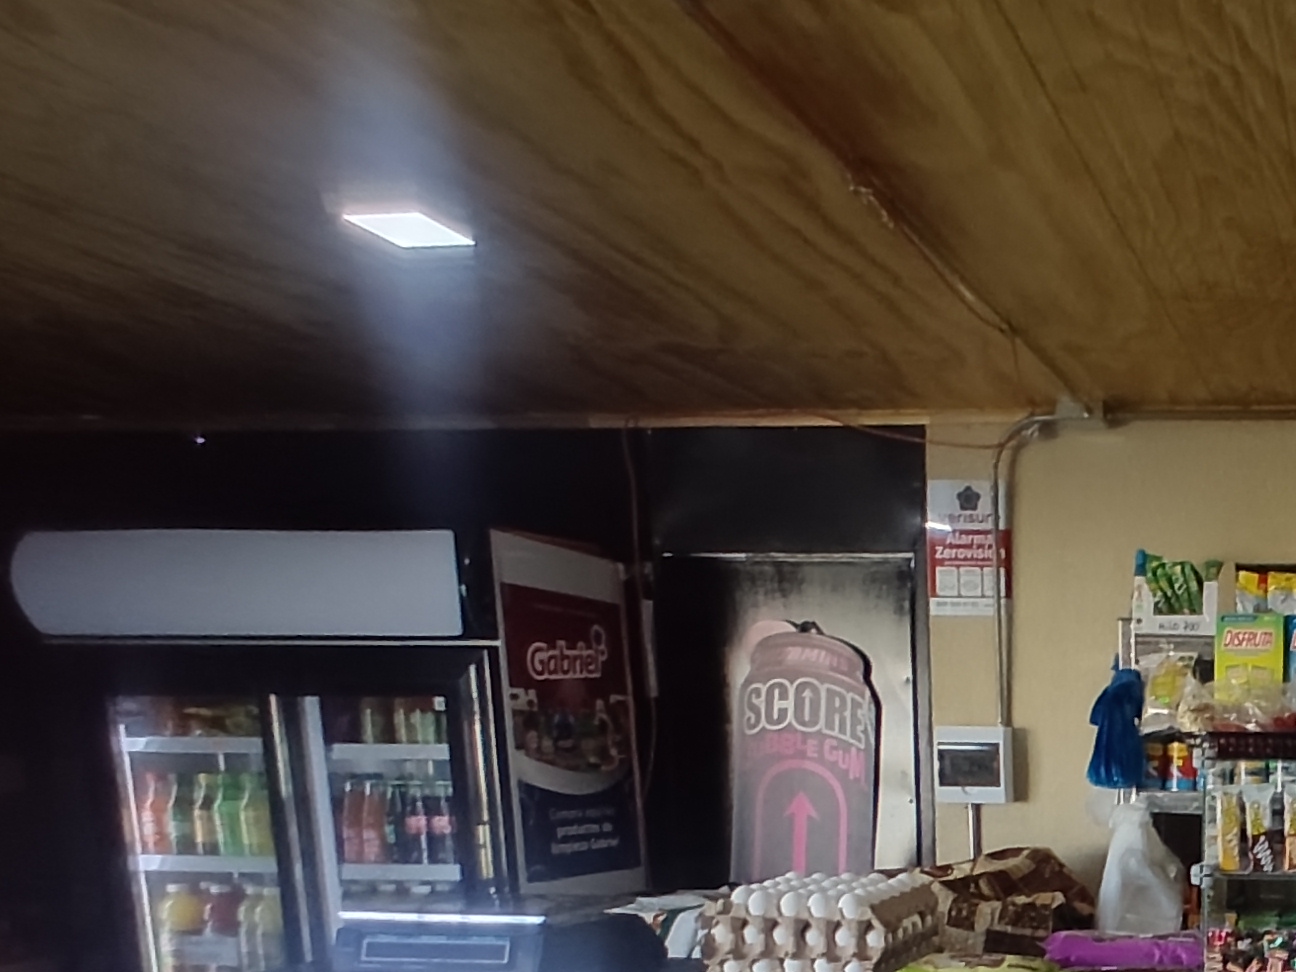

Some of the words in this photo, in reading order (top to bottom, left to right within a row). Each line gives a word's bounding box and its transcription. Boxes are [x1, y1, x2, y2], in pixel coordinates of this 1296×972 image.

[527, 630, 605, 680] Gabriel
[1223, 630, 1274, 649] DISFRUTA
[743, 677, 867, 749] SCORE
[823, 738, 866, 780] GUM
